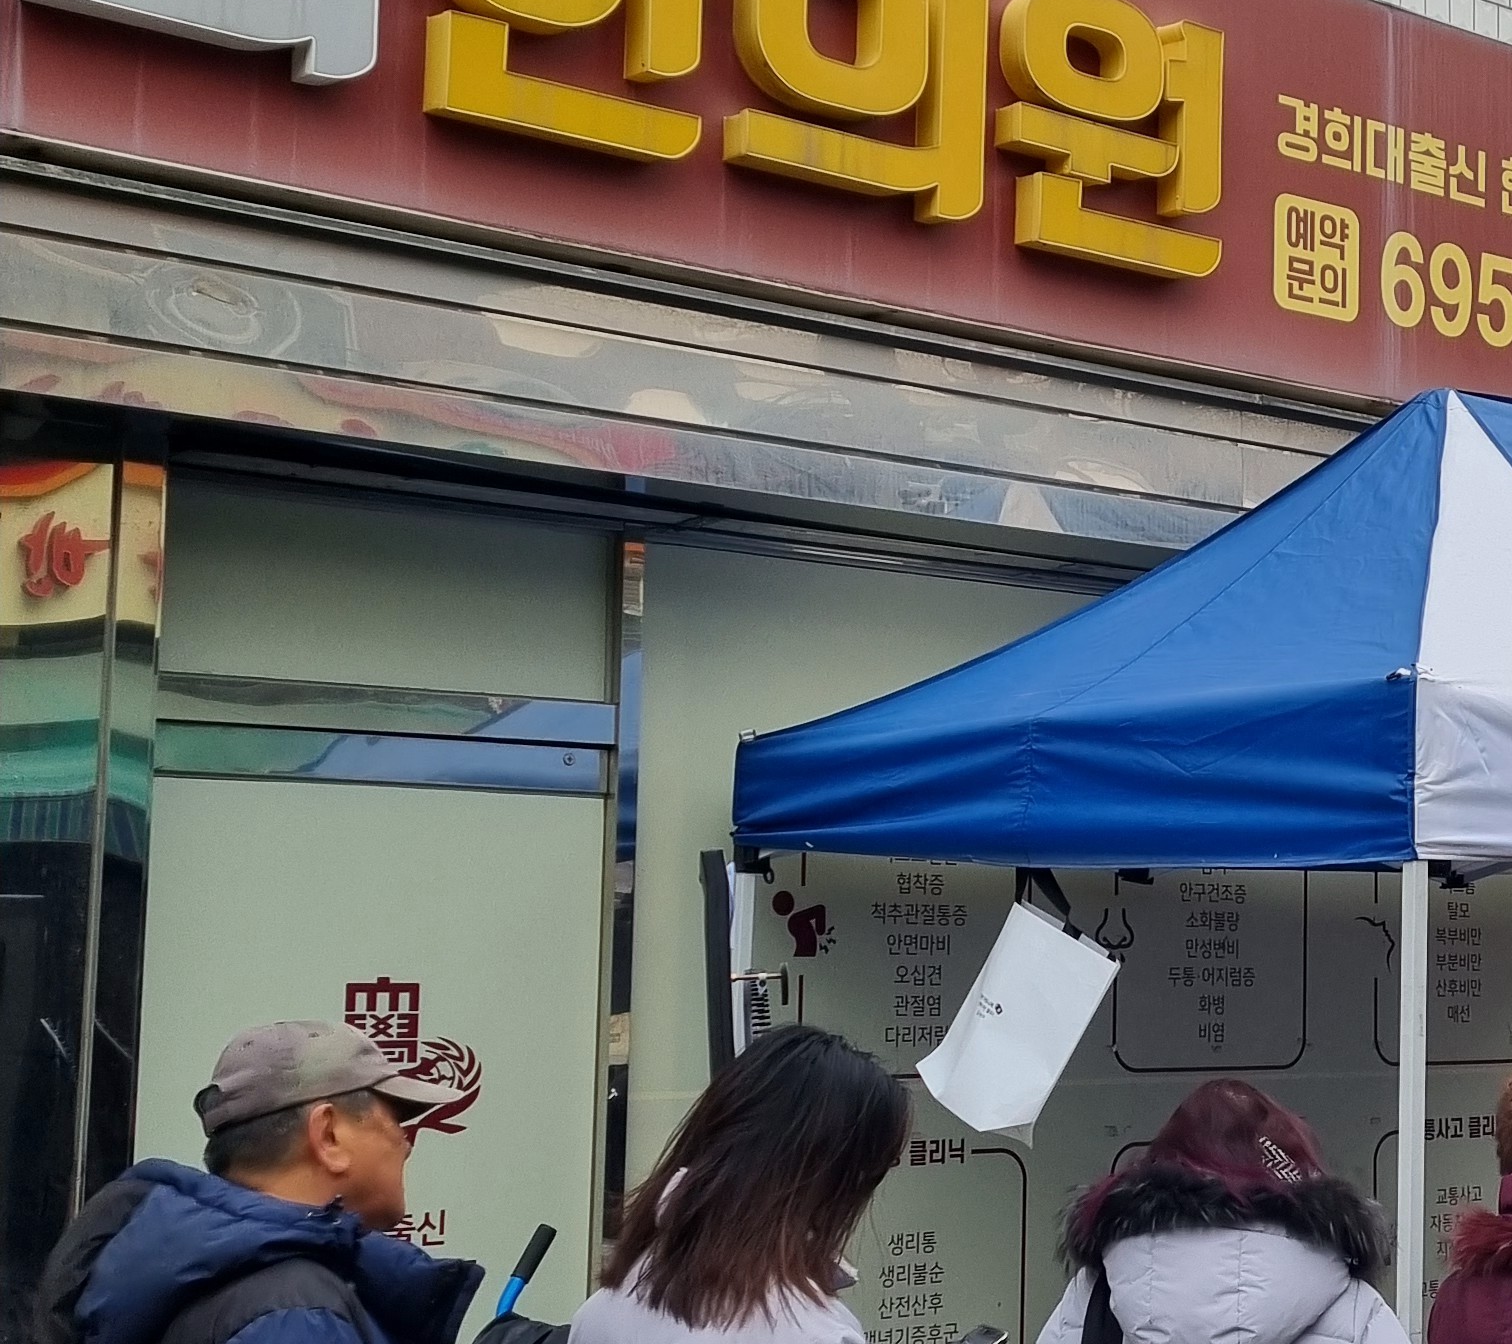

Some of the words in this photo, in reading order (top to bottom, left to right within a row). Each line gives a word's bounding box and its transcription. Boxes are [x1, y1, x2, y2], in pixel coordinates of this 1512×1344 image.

[1277, 94, 1487, 208] 경희대출신
[1286, 205, 1350, 261] 예약
[1286, 255, 1348, 309] 문의
[896, 872, 945, 896] 협착증
[1179, 882, 1247, 905] 안구건조증
[871, 901, 968, 926] 척추관절통증
[1185, 910, 1240, 932] 소화불량
[1447, 902, 1471, 921] 탈모
[886, 933, 951, 956] 안면마비
[1185, 937, 1240, 960] 만성변비
[1435, 927, 1483, 947] 복부비만
[1435, 953, 1483, 972] 부분비만
[893, 964, 942, 986] 오십견
[1435, 978, 1483, 998] 산후비만
[893, 994, 942, 1017] 관절염
[1198, 994, 1225, 1015] 화병
[1447, 1004, 1471, 1023] 매선
[1198, 1022, 1225, 1043] 비염
[1424, 1118, 1463, 1141] 통사고
[1468, 1115, 1497, 1138] 클리
[909, 1138, 965, 1167] 클리닉
[1435, 1185, 1483, 1205] 교통사고
[887, 1231, 938, 1256] 생리통
[878, 1261, 946, 1289] 생리불순
[877, 1291, 945, 1320] 산전산후
